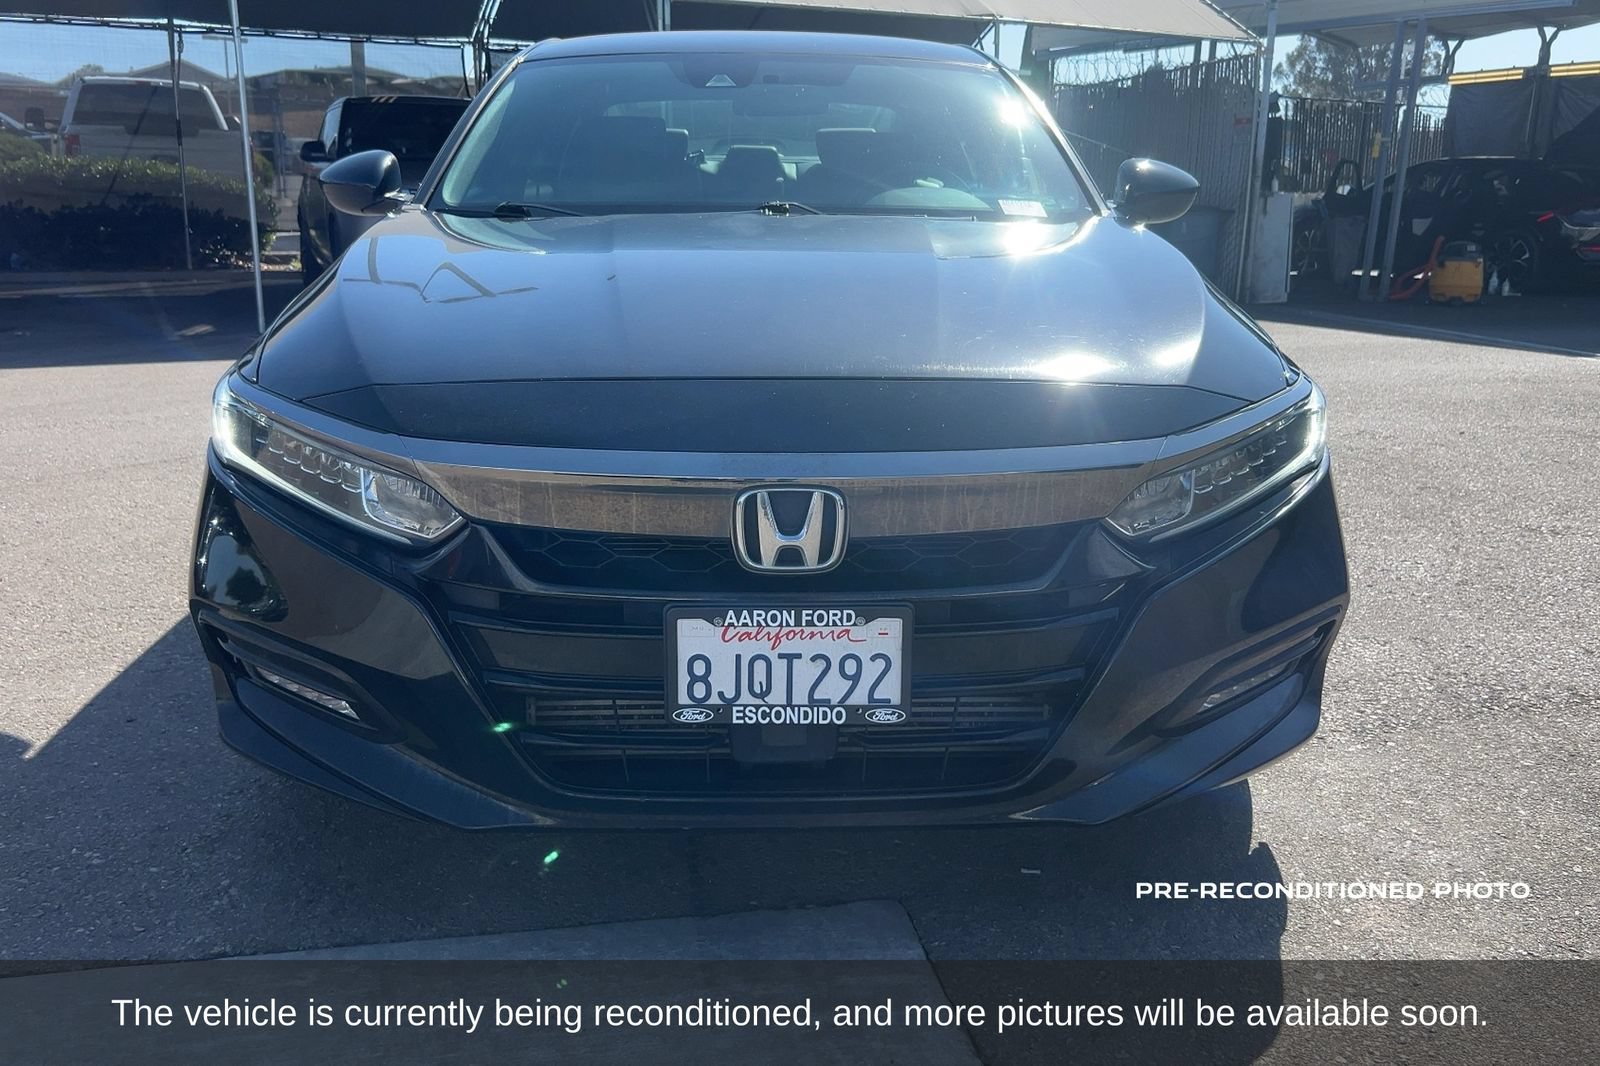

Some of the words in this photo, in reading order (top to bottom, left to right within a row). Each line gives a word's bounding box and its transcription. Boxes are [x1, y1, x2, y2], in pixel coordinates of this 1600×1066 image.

[723, 609, 795, 627] AARON
[801, 609, 856, 627] FORD
[721, 625, 867, 651] California
[686, 652, 893, 705] 8JQT292
[732, 706, 847, 725] ESCONDIDO
